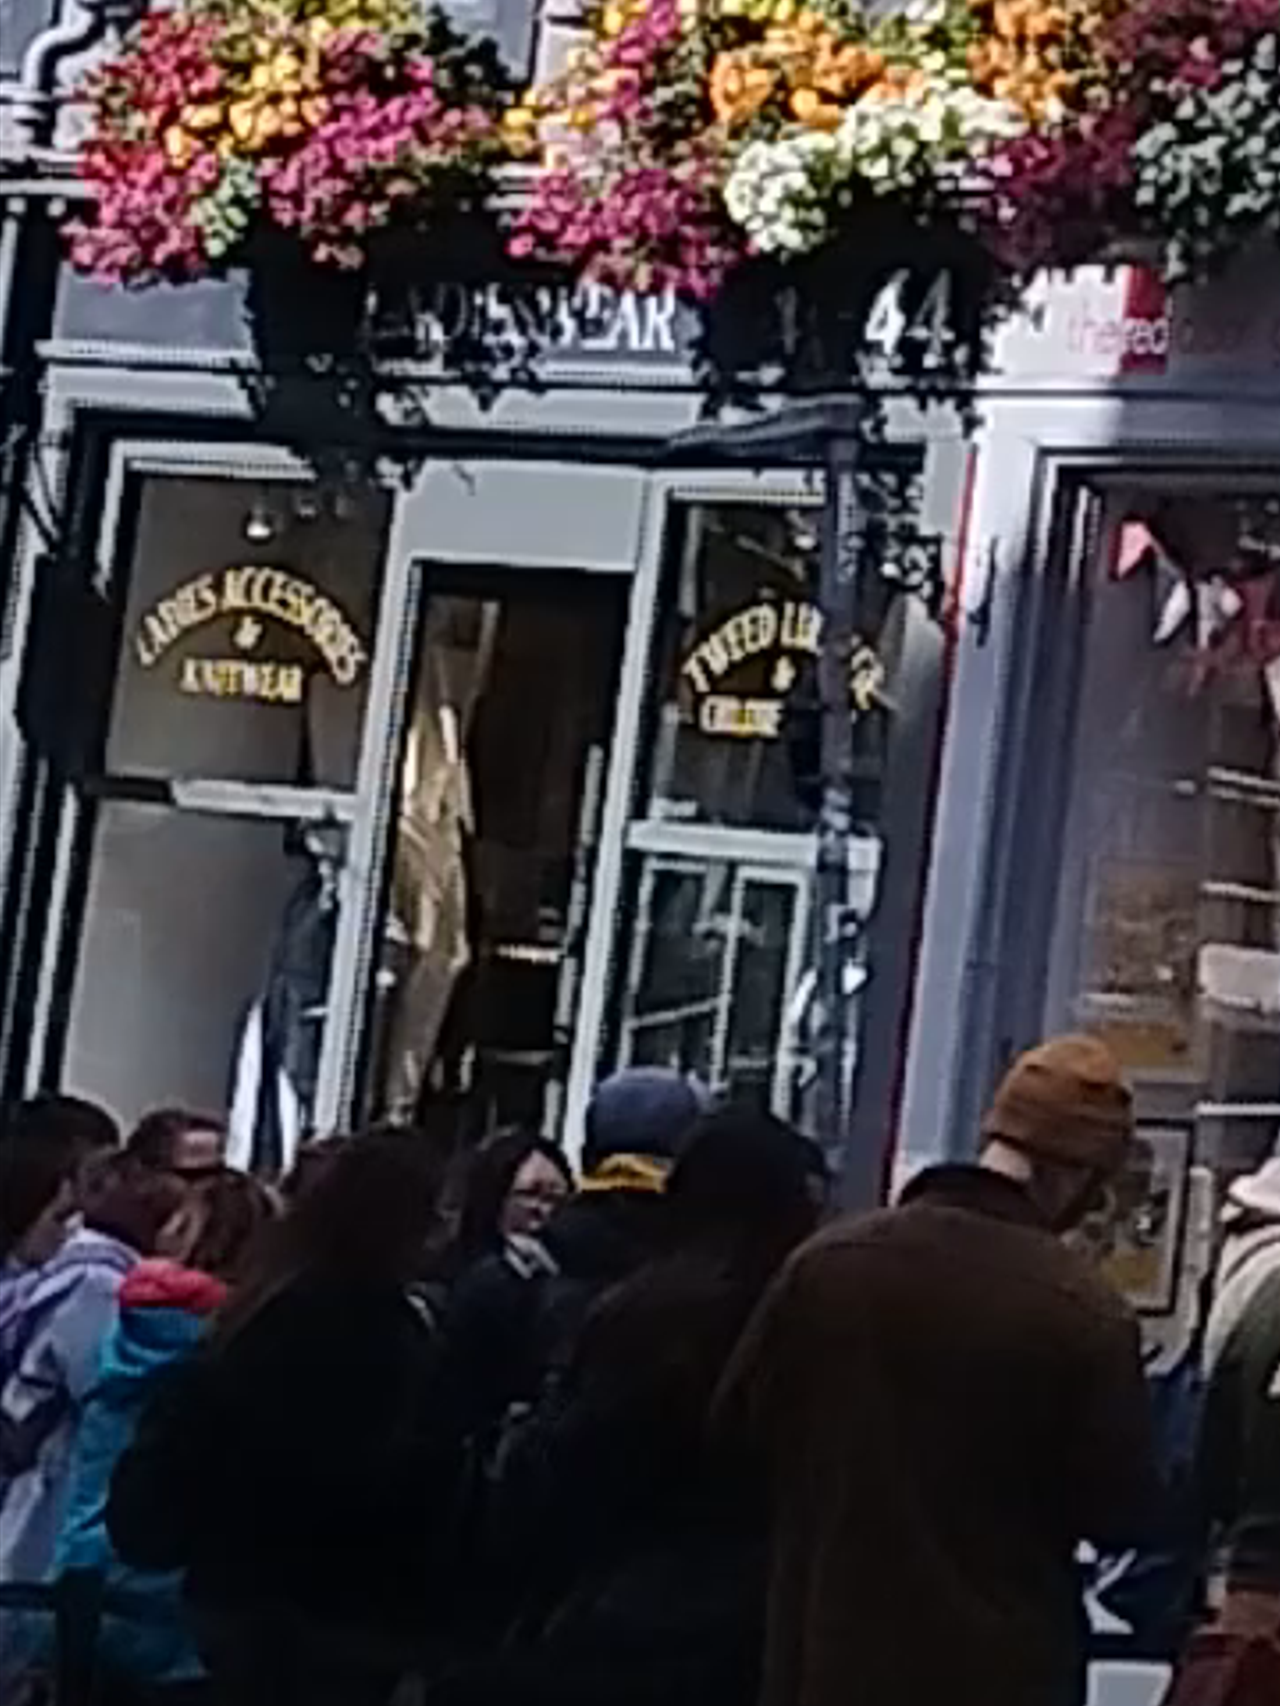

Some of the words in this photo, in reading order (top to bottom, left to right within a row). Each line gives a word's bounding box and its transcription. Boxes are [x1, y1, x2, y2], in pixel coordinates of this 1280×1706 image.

[136, 573, 217, 667] LADIES
[221, 565, 367, 684] ACCESSORIES
[681, 602, 778, 693] TWEED
